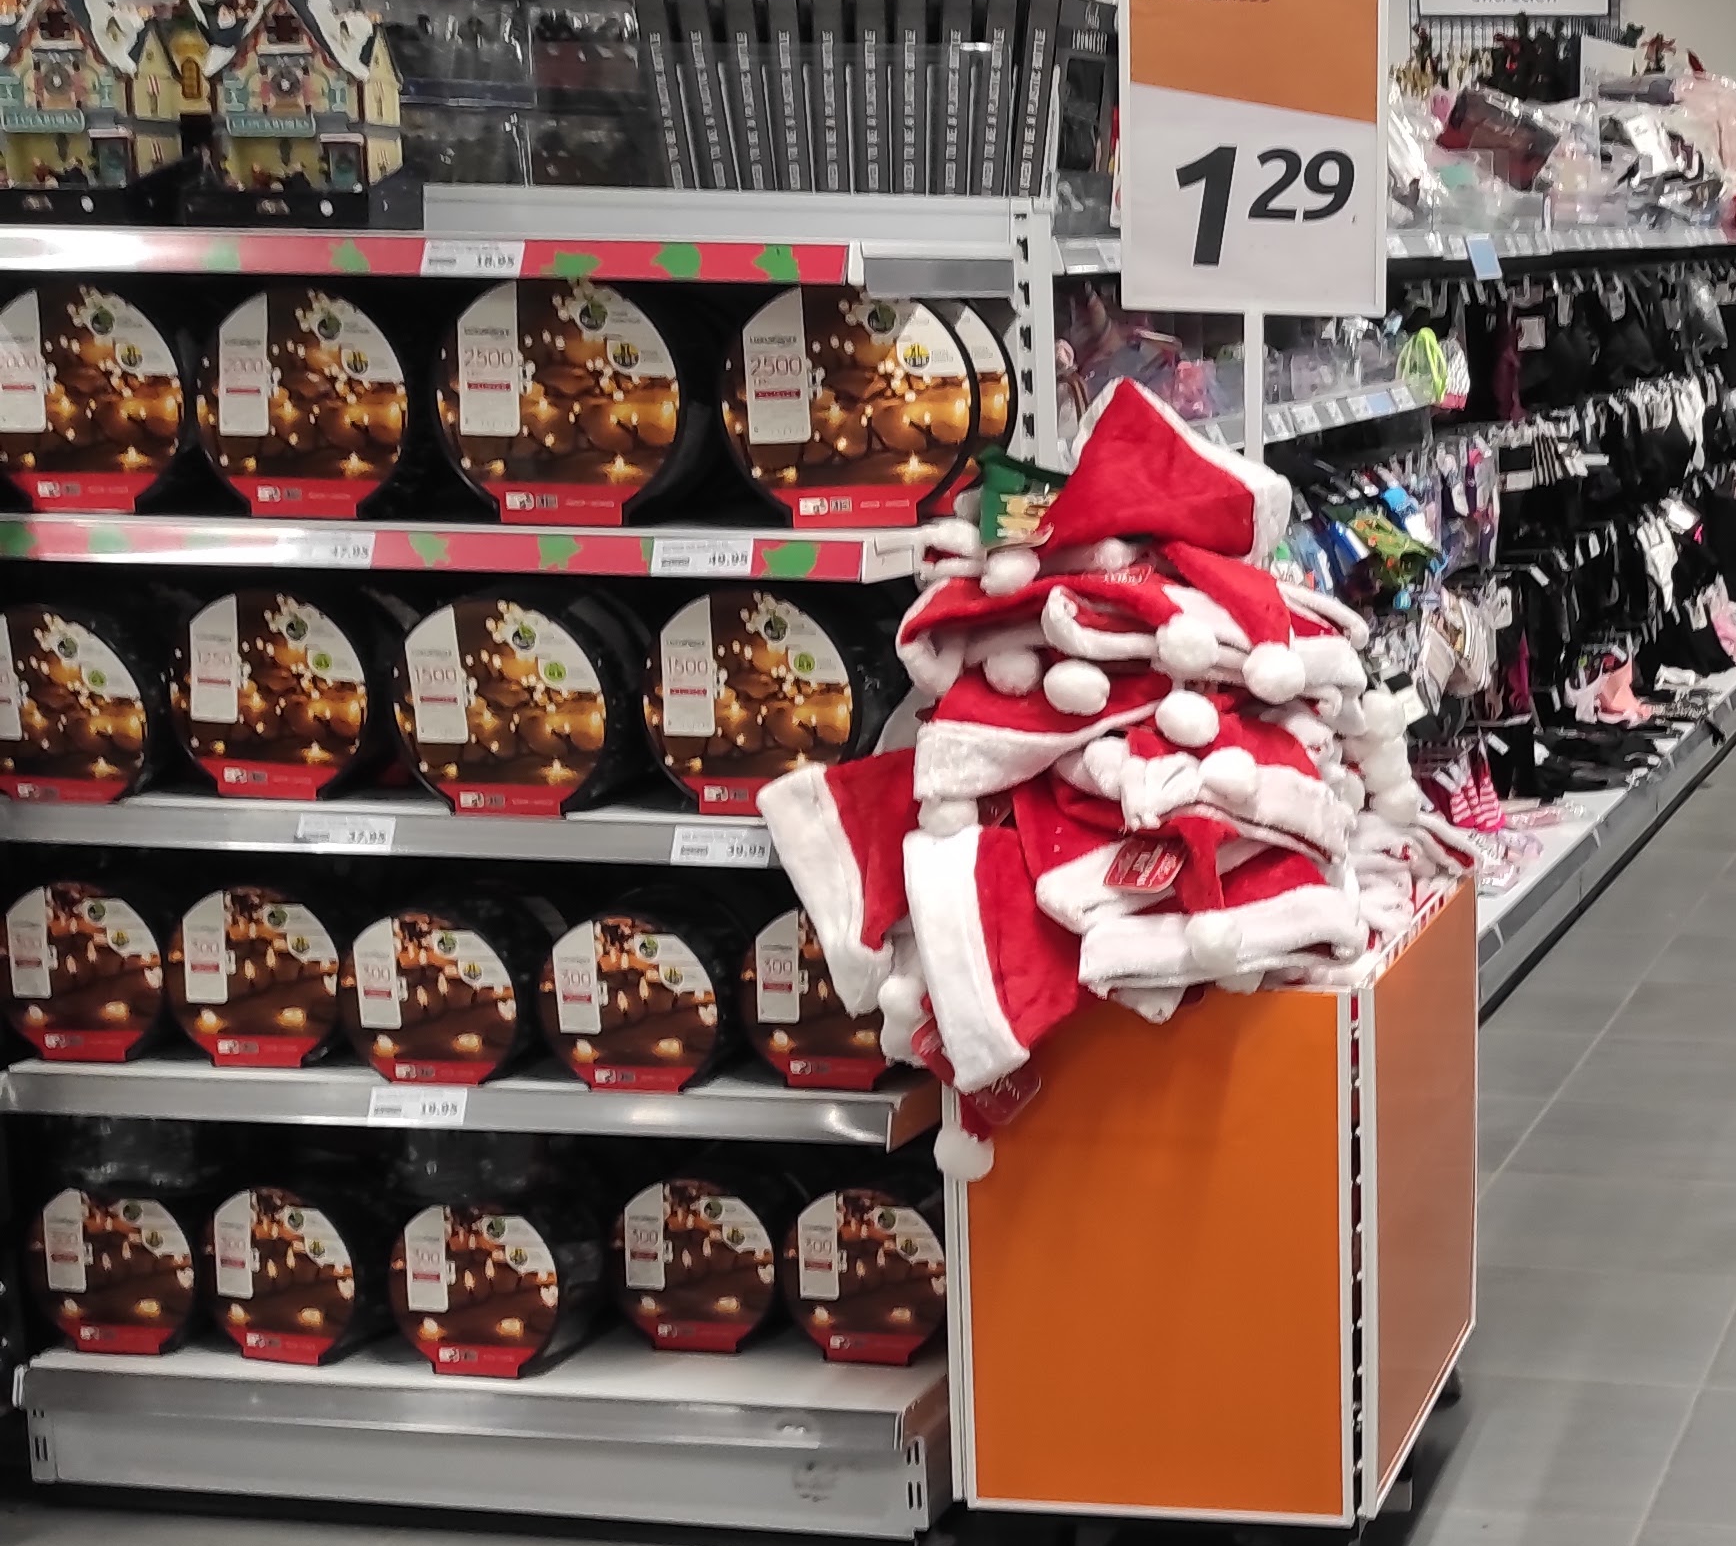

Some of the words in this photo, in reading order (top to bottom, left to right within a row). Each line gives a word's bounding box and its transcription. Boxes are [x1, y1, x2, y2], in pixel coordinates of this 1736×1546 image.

[1176, 146, 1237, 267] 1
[1248, 148, 1355, 222] 29
[464, 348, 513, 369] 2500
[750, 354, 803, 377] 2500
